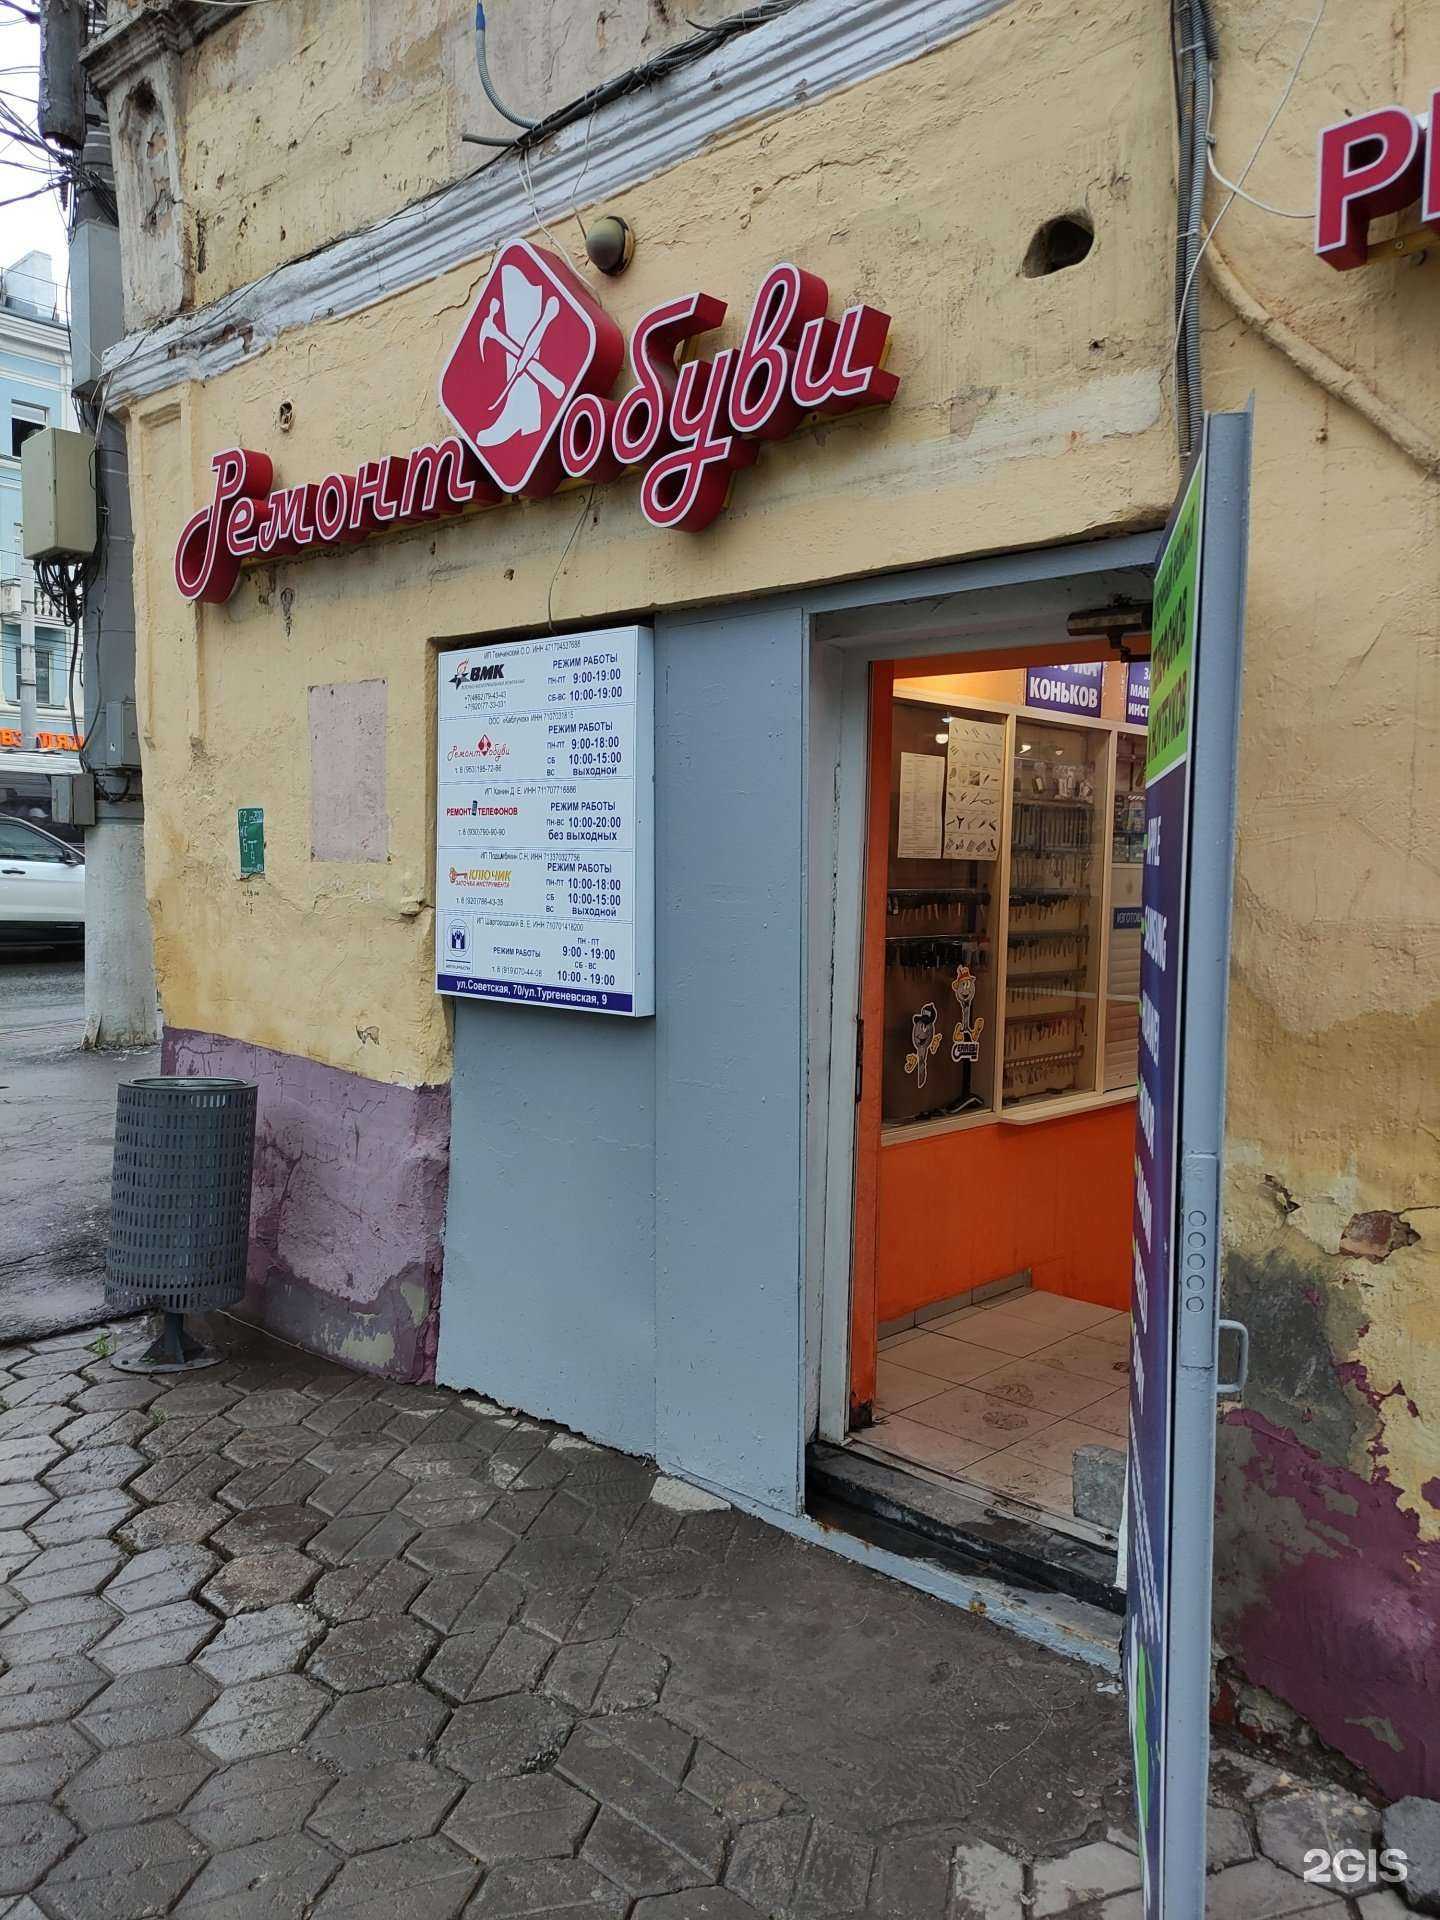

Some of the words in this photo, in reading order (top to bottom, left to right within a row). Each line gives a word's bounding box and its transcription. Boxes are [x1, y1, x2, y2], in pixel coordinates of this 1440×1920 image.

[174, 436, 476, 602] Ремонт
[559, 262, 885, 530] обуви
[553, 657, 581, 669] РЕЖИМ
[583, 653, 618, 666] РАБОТЫ
[470, 664, 505, 681] ВМК
[573, 668, 621, 684] 9:00-19:00
[569, 686, 622, 701] 10:00-19:00
[1029, 676, 1098, 708] КОНЬКОВ
[1130, 683, 1150, 699] МАН
[1128, 702, 1150, 717] ИНСТ
[548, 724, 577, 734] РЕЖИМ
[578, 722, 613, 732] РАБОТЫ
[572, 736, 620, 750] 9:00-18:00
[546, 756, 556, 764] СБ
[569, 751, 622, 765] 10:00-15:00
[546, 768, 555, 776] ВС
[446, 808, 472, 816] РЕМОНТ
[478, 807, 518, 816] ТЕЛЕФОНОВ
[550, 802, 579, 811] РЕЖИМ
[581, 801, 616, 811] РАБОТЫ
[569, 816, 622, 828] 10:00-20:00
[548, 829, 564, 840] без
[566, 832, 618, 842] выходных
[547, 862, 576, 872] РЕЖИМ
[578, 863, 612, 873] РАБОТЫ
[568, 878, 621, 890] 10:00-18:00
[568, 892, 621, 906] 10:00-15:00
[493, 946, 514, 956] РЕЖИМ
[516, 948, 541, 958] РАБОТЫ
[562, 946, 582, 958] 9:00
[590, 948, 616, 960] 19:00
[558, 970, 581, 982] 10:00
[590, 973, 615, 986] 19:00
[456, 980, 511, 995] ул.Советская,
[602, 994, 608, 1004] 9
